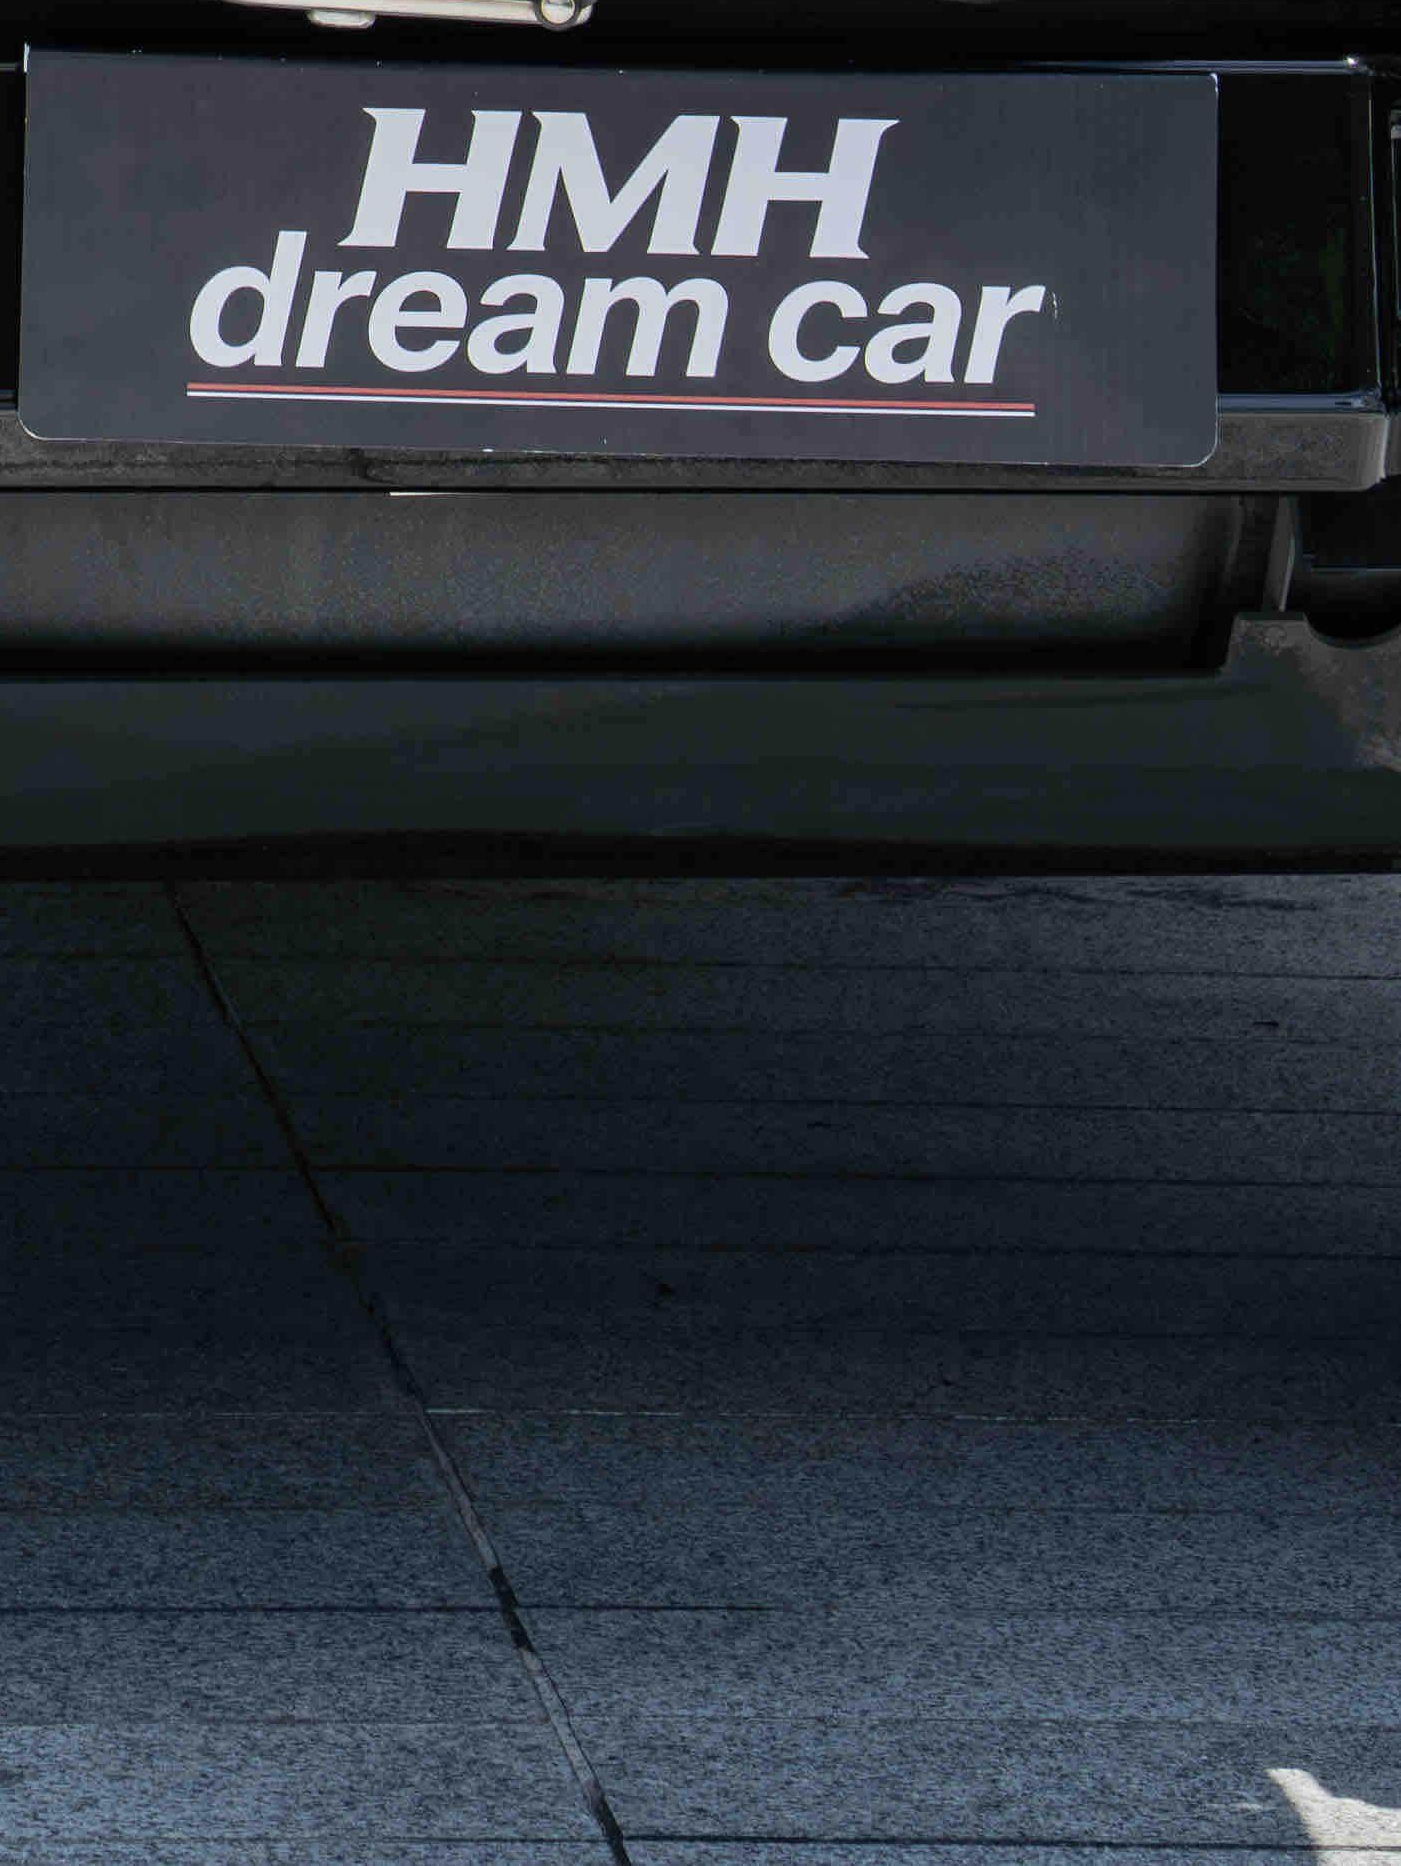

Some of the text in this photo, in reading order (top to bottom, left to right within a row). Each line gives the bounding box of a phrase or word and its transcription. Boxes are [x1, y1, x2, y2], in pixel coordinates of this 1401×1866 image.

[337, 107, 899, 259] HMH
[189, 230, 1046, 385] dream car
